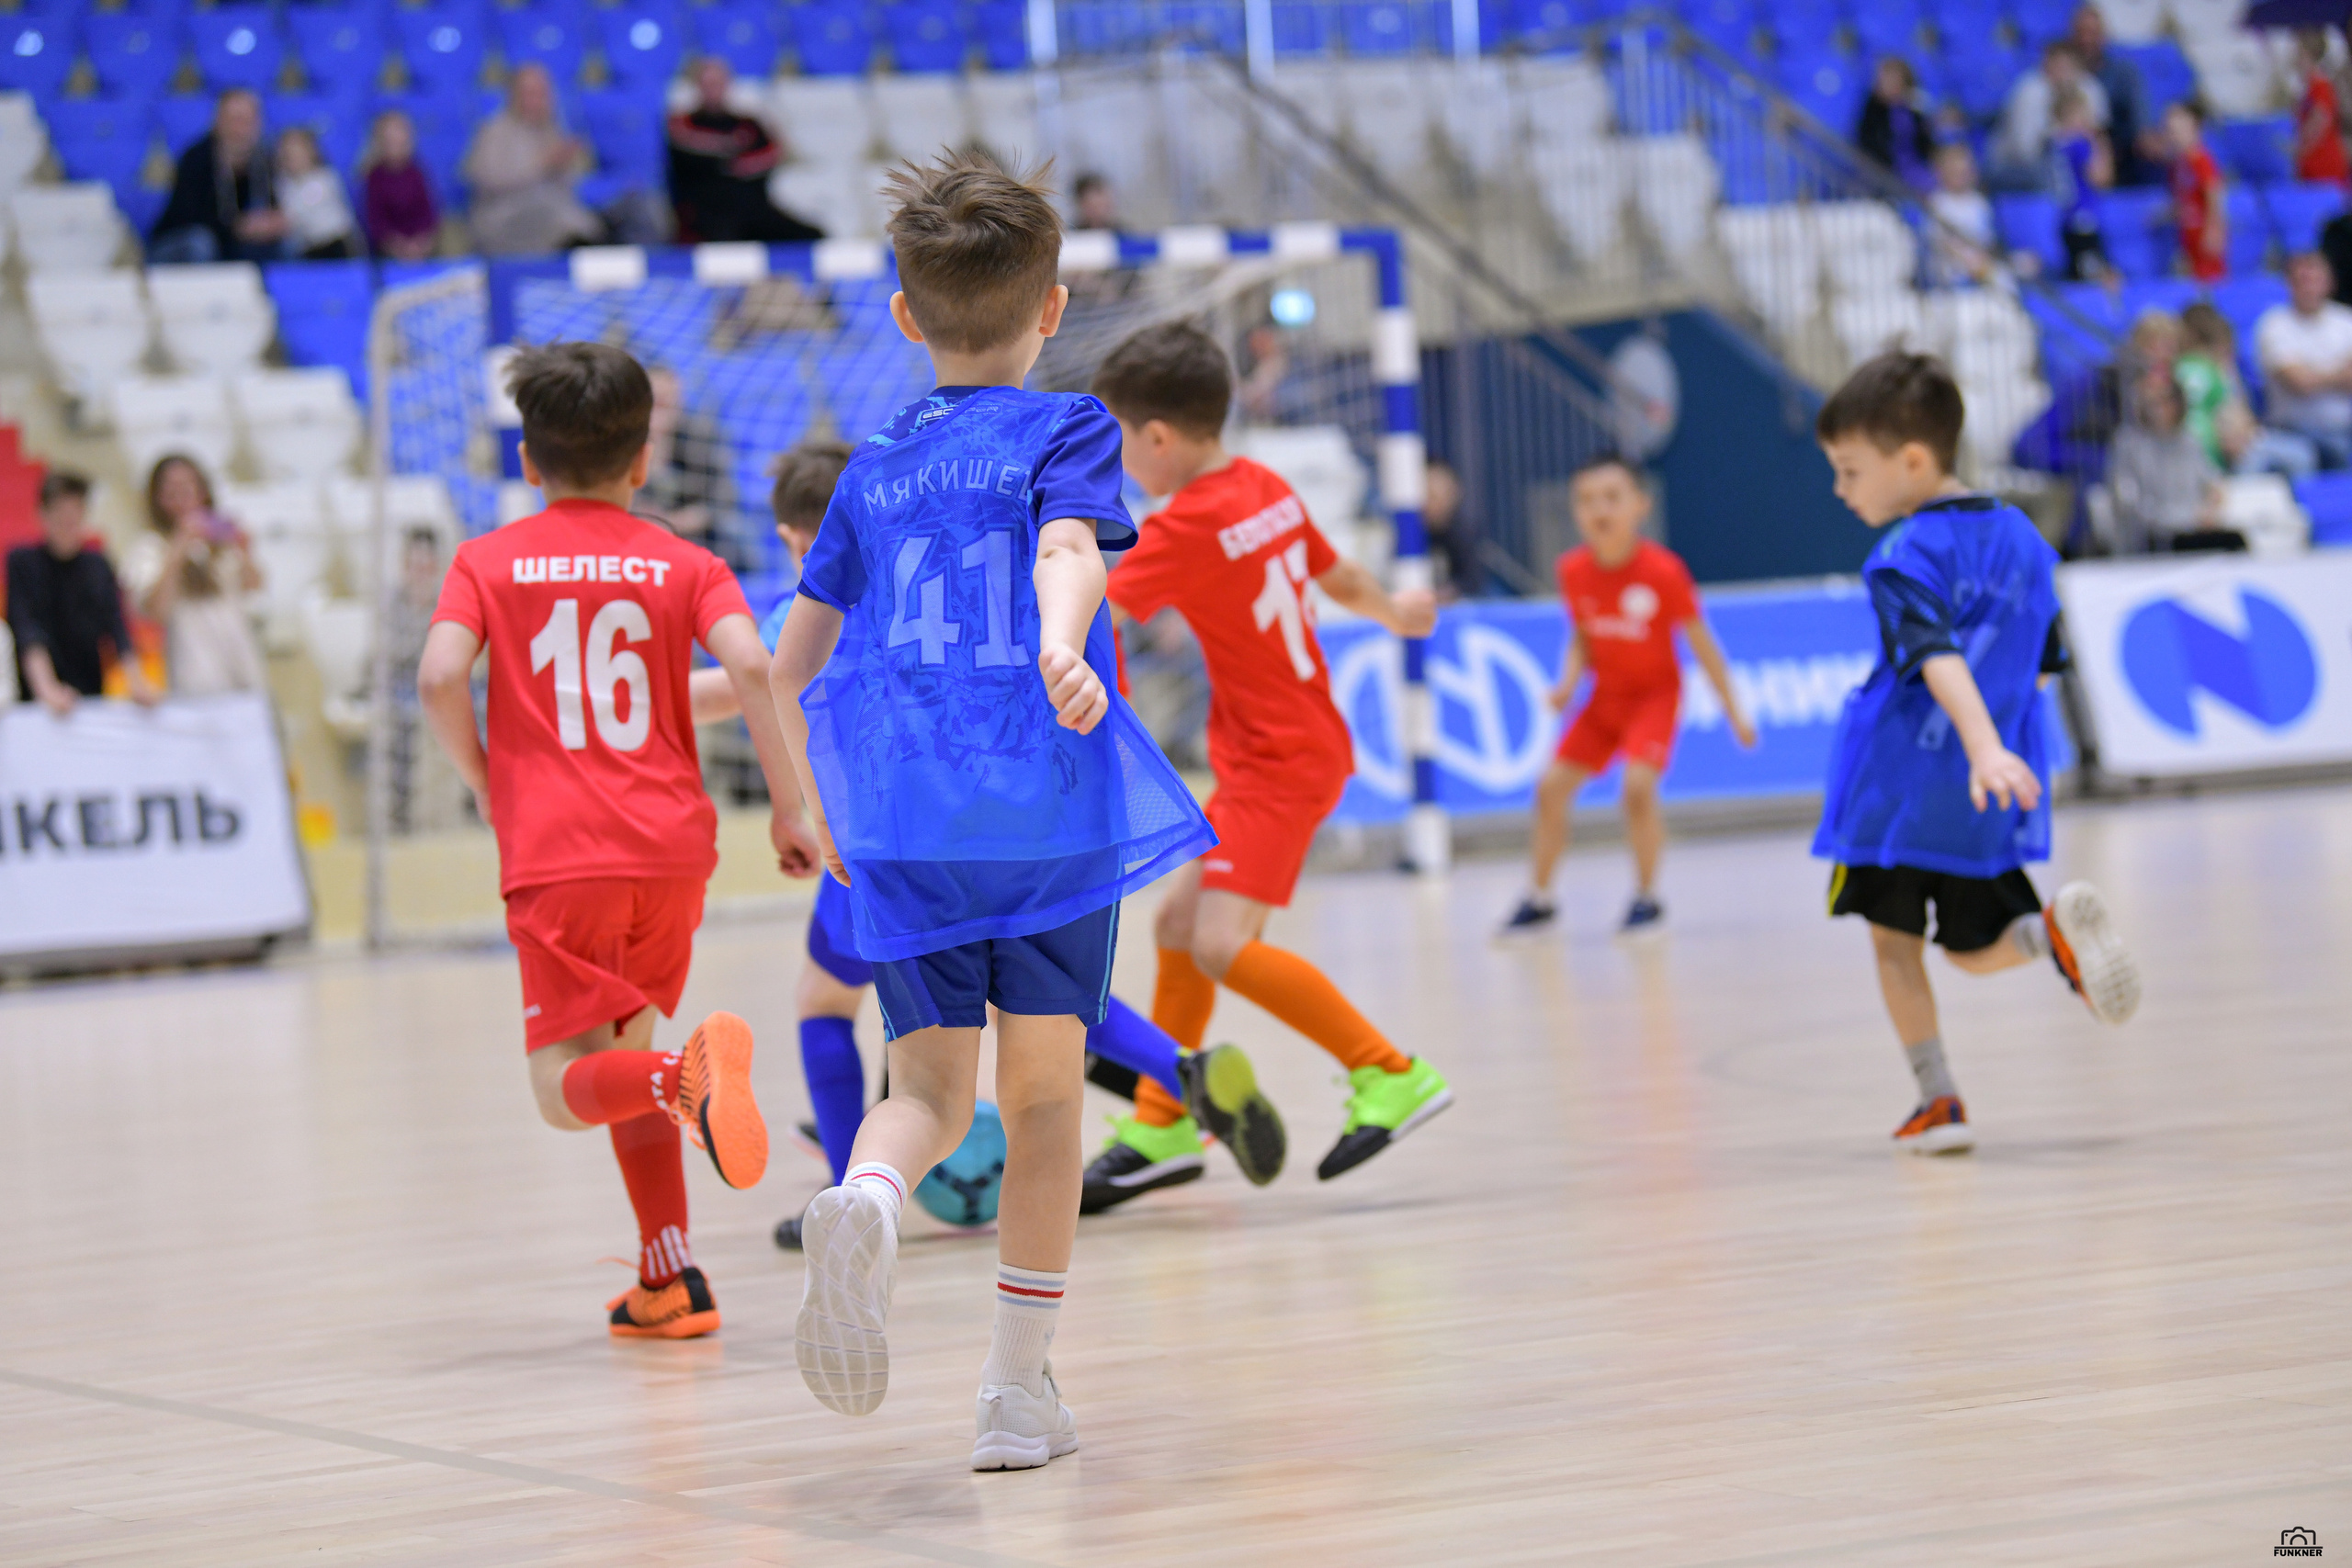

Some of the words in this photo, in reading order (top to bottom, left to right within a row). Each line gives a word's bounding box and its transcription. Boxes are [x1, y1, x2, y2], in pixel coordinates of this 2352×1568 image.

[512, 554, 671, 588] ШЕЛЕСТ
[887, 529, 1031, 671] 41
[529, 597, 652, 752] 16
[0, 784, 243, 856] КЕЛЬ
